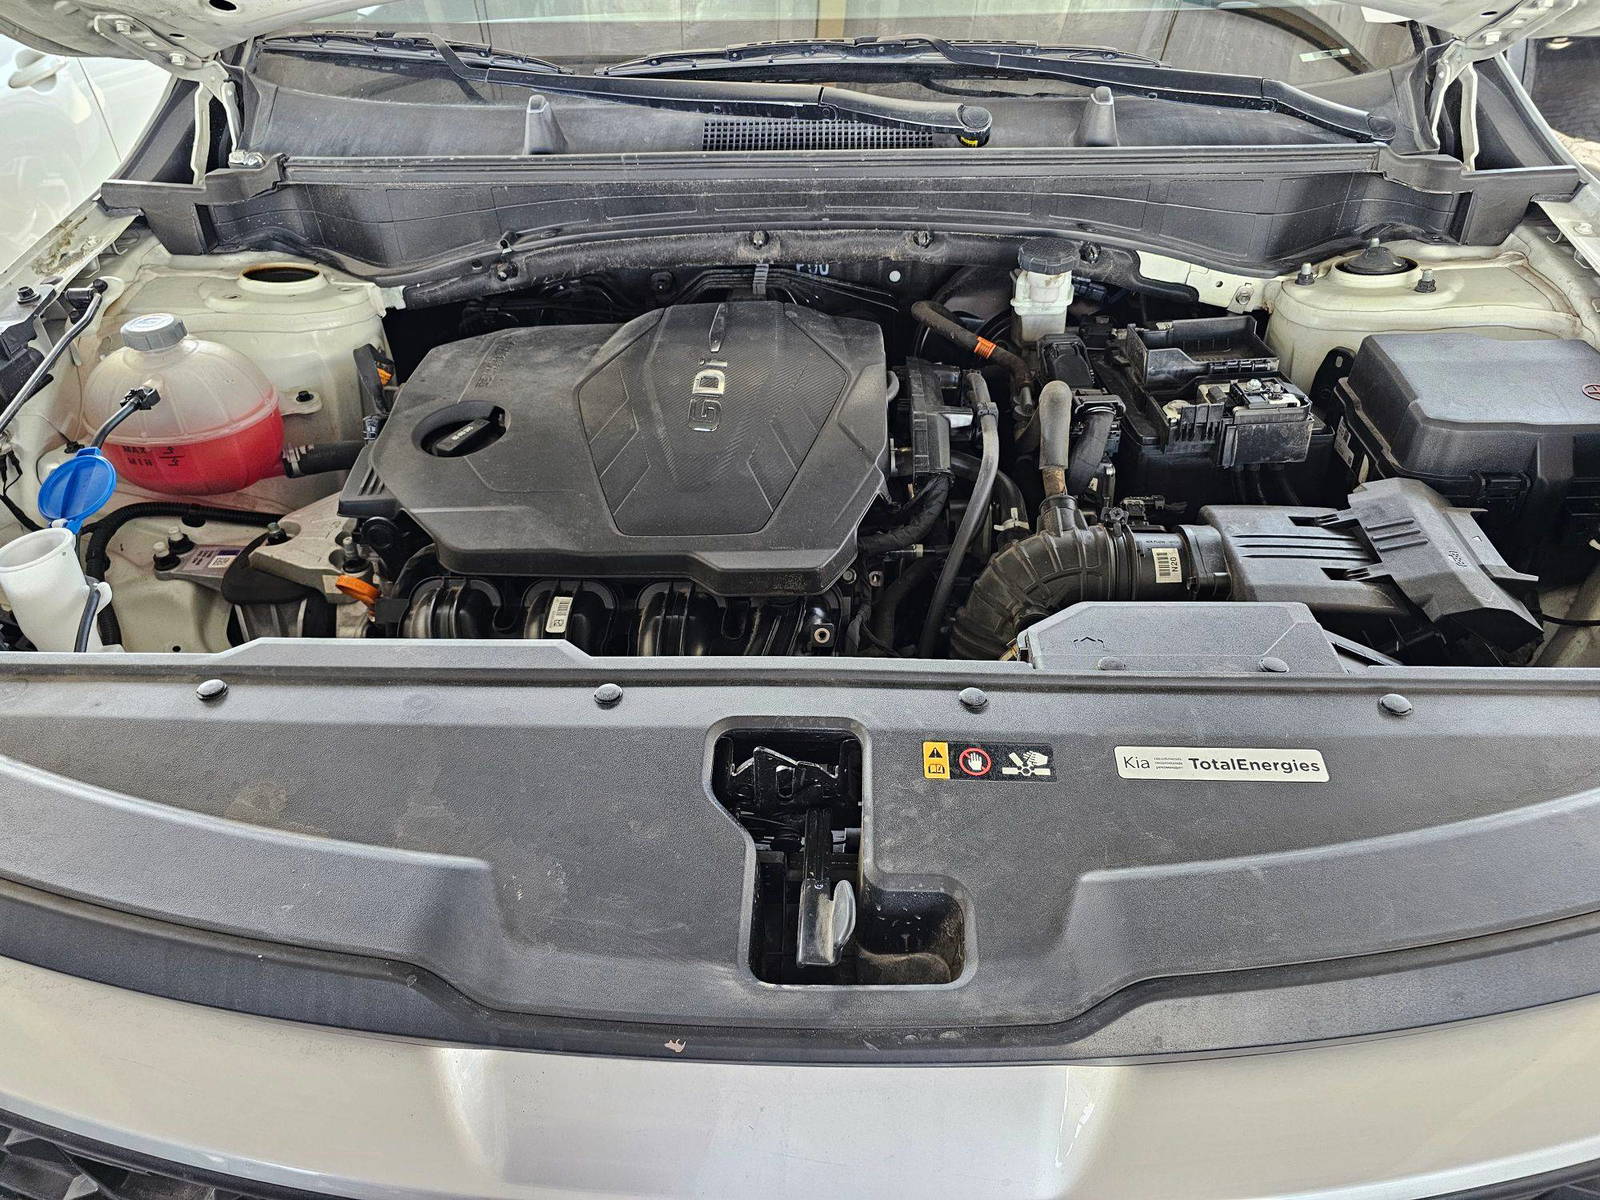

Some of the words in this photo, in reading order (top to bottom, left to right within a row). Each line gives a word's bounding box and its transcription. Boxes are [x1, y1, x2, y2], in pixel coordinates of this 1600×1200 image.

[688, 359, 728, 432] GDi
[122, 446, 146, 454] MAX
[128, 457, 153, 466] MIN
[1170, 556, 1179, 573] N20
[1123, 756, 1150, 769] Kia
[1188, 758, 1321, 773] TotalEnergies
